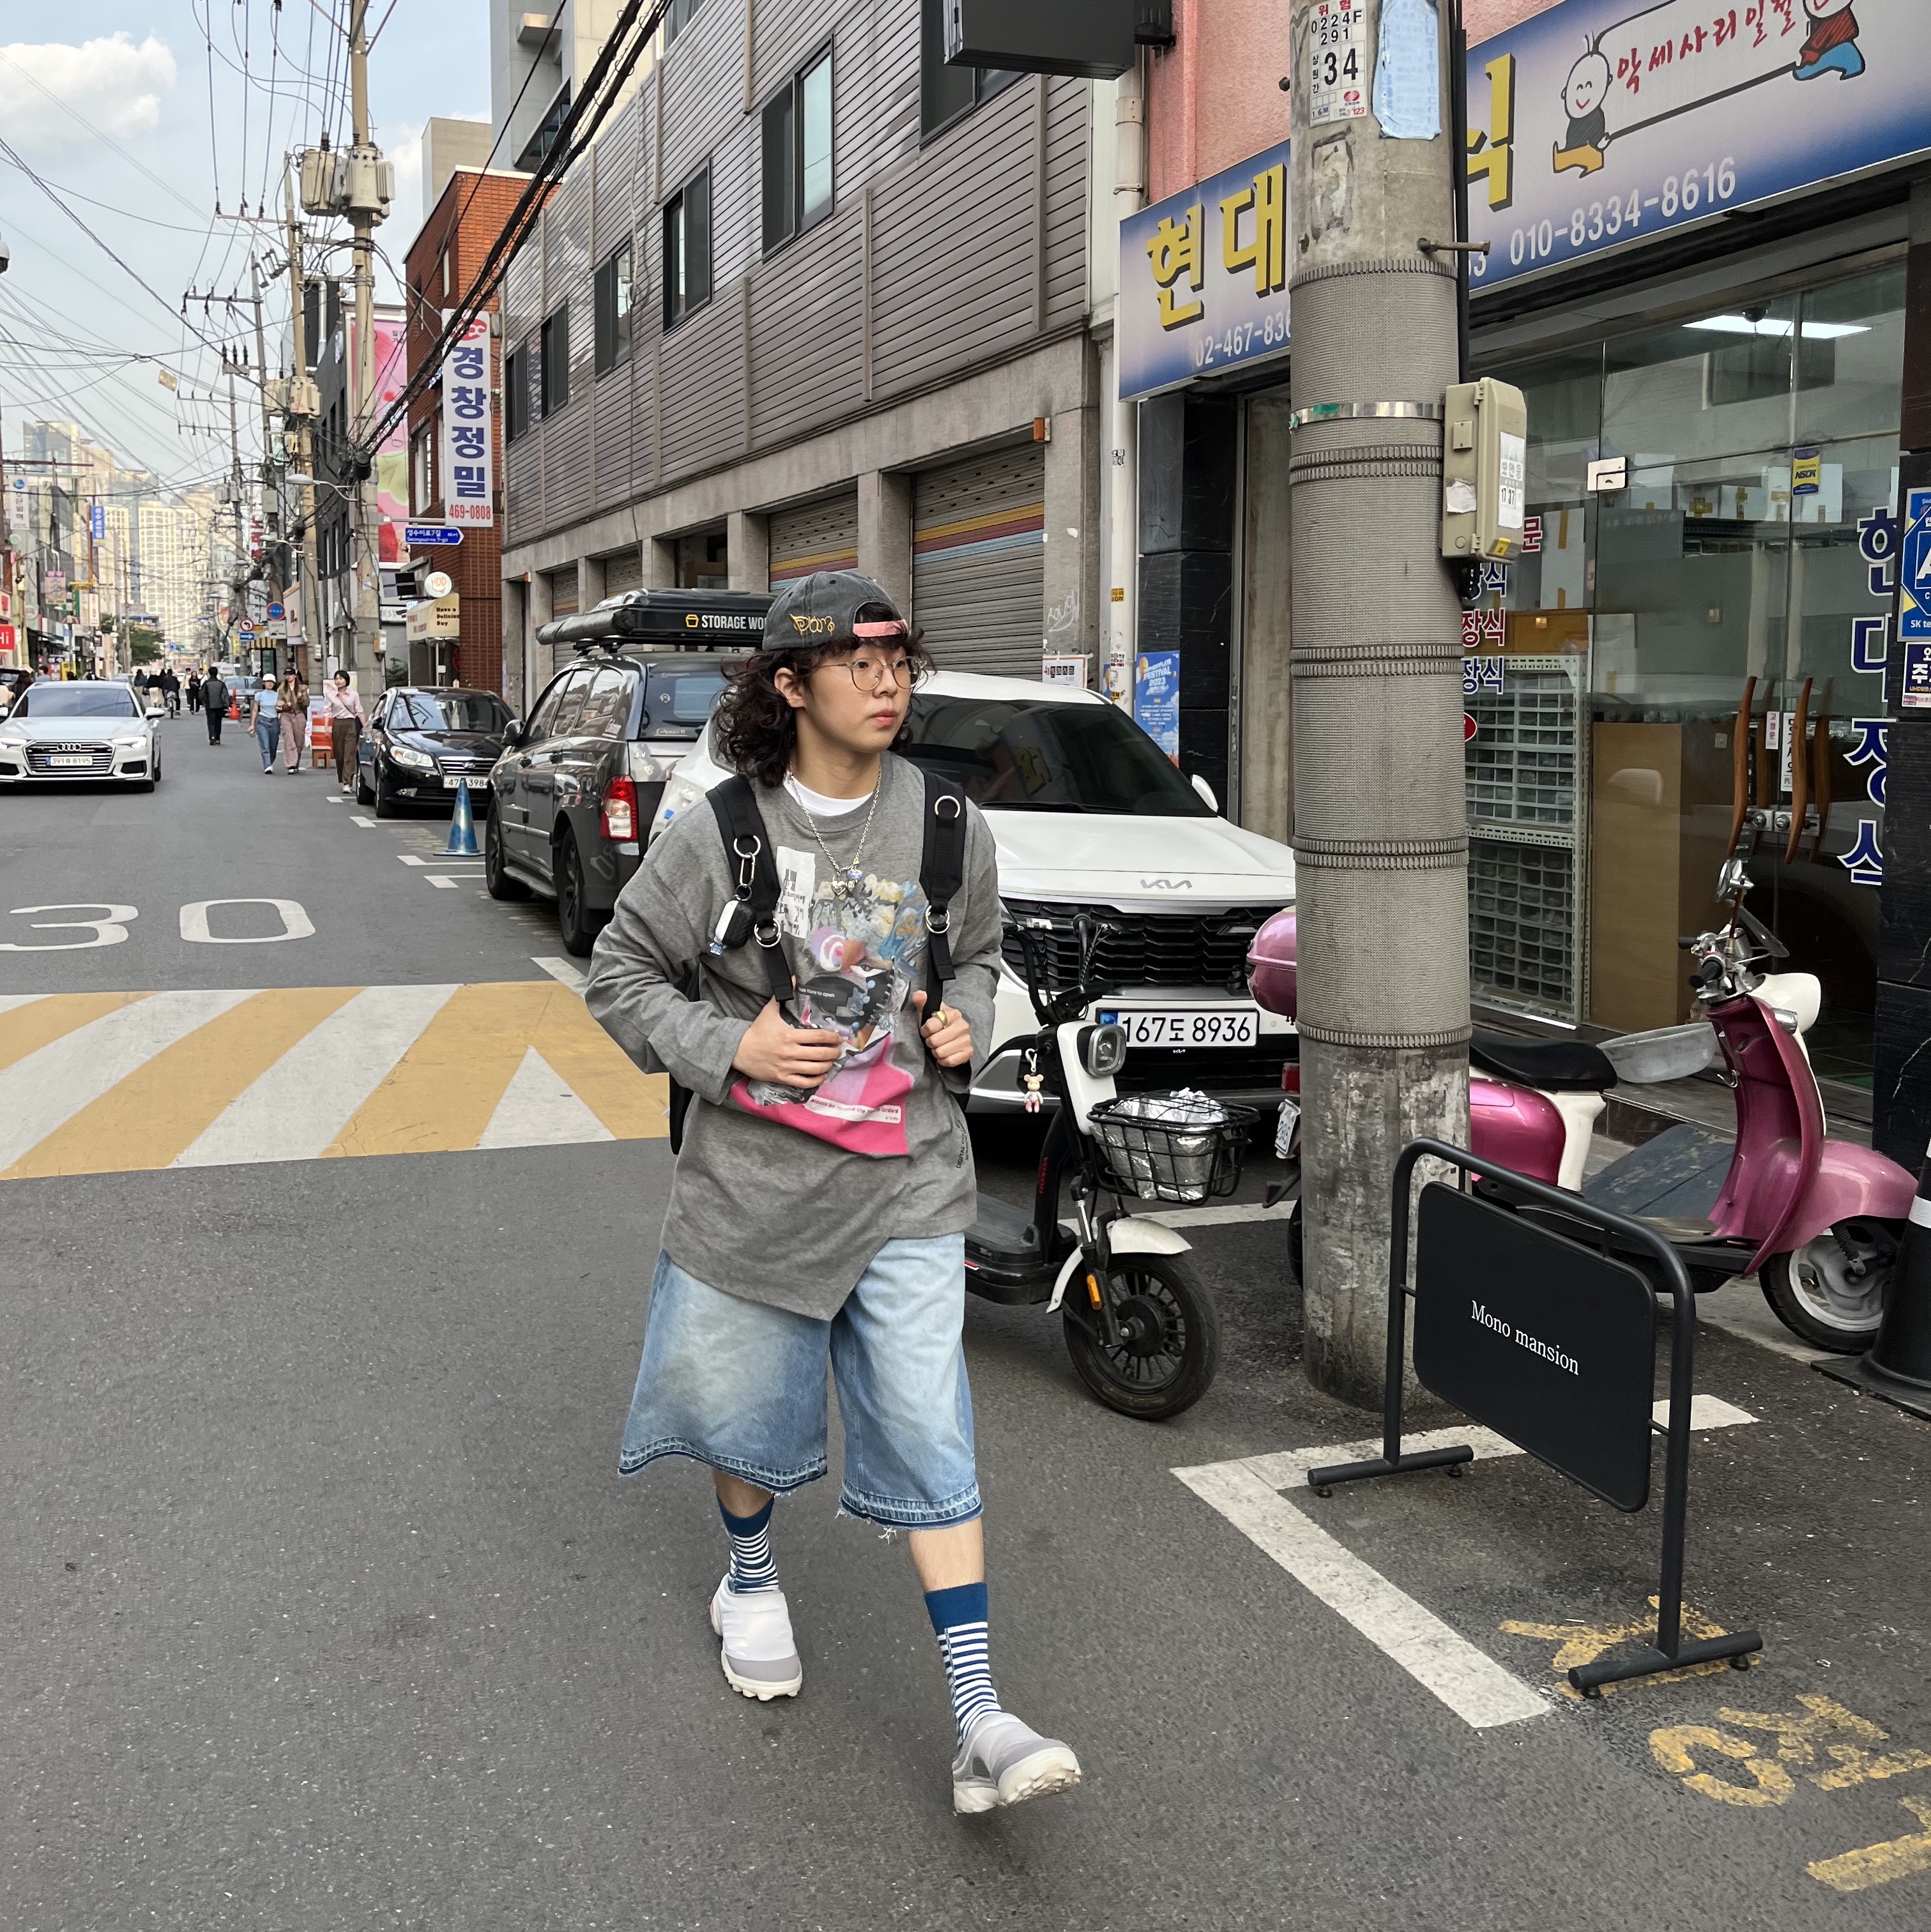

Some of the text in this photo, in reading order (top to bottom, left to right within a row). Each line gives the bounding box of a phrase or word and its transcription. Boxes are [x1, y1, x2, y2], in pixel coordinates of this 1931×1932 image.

[1311, 10, 1362, 33] 0224F
[1320, 27, 1348, 46] 291
[1324, 48, 1358, 86] 34
[1352, 107, 1364, 116] 123
[1510, 156, 1736, 266] 010-8334-8616
[451, 346, 487, 499] 경창정밀
[449, 505, 491, 521] 469-0808
[431, 577, 446, 586] HDD
[701, 614, 747, 630] STORAGE
[1149, 676, 1166, 687] 2023
[1192, 1017, 1251, 1042] 8936
[1470, 1300, 1580, 1376] Mono mansion
